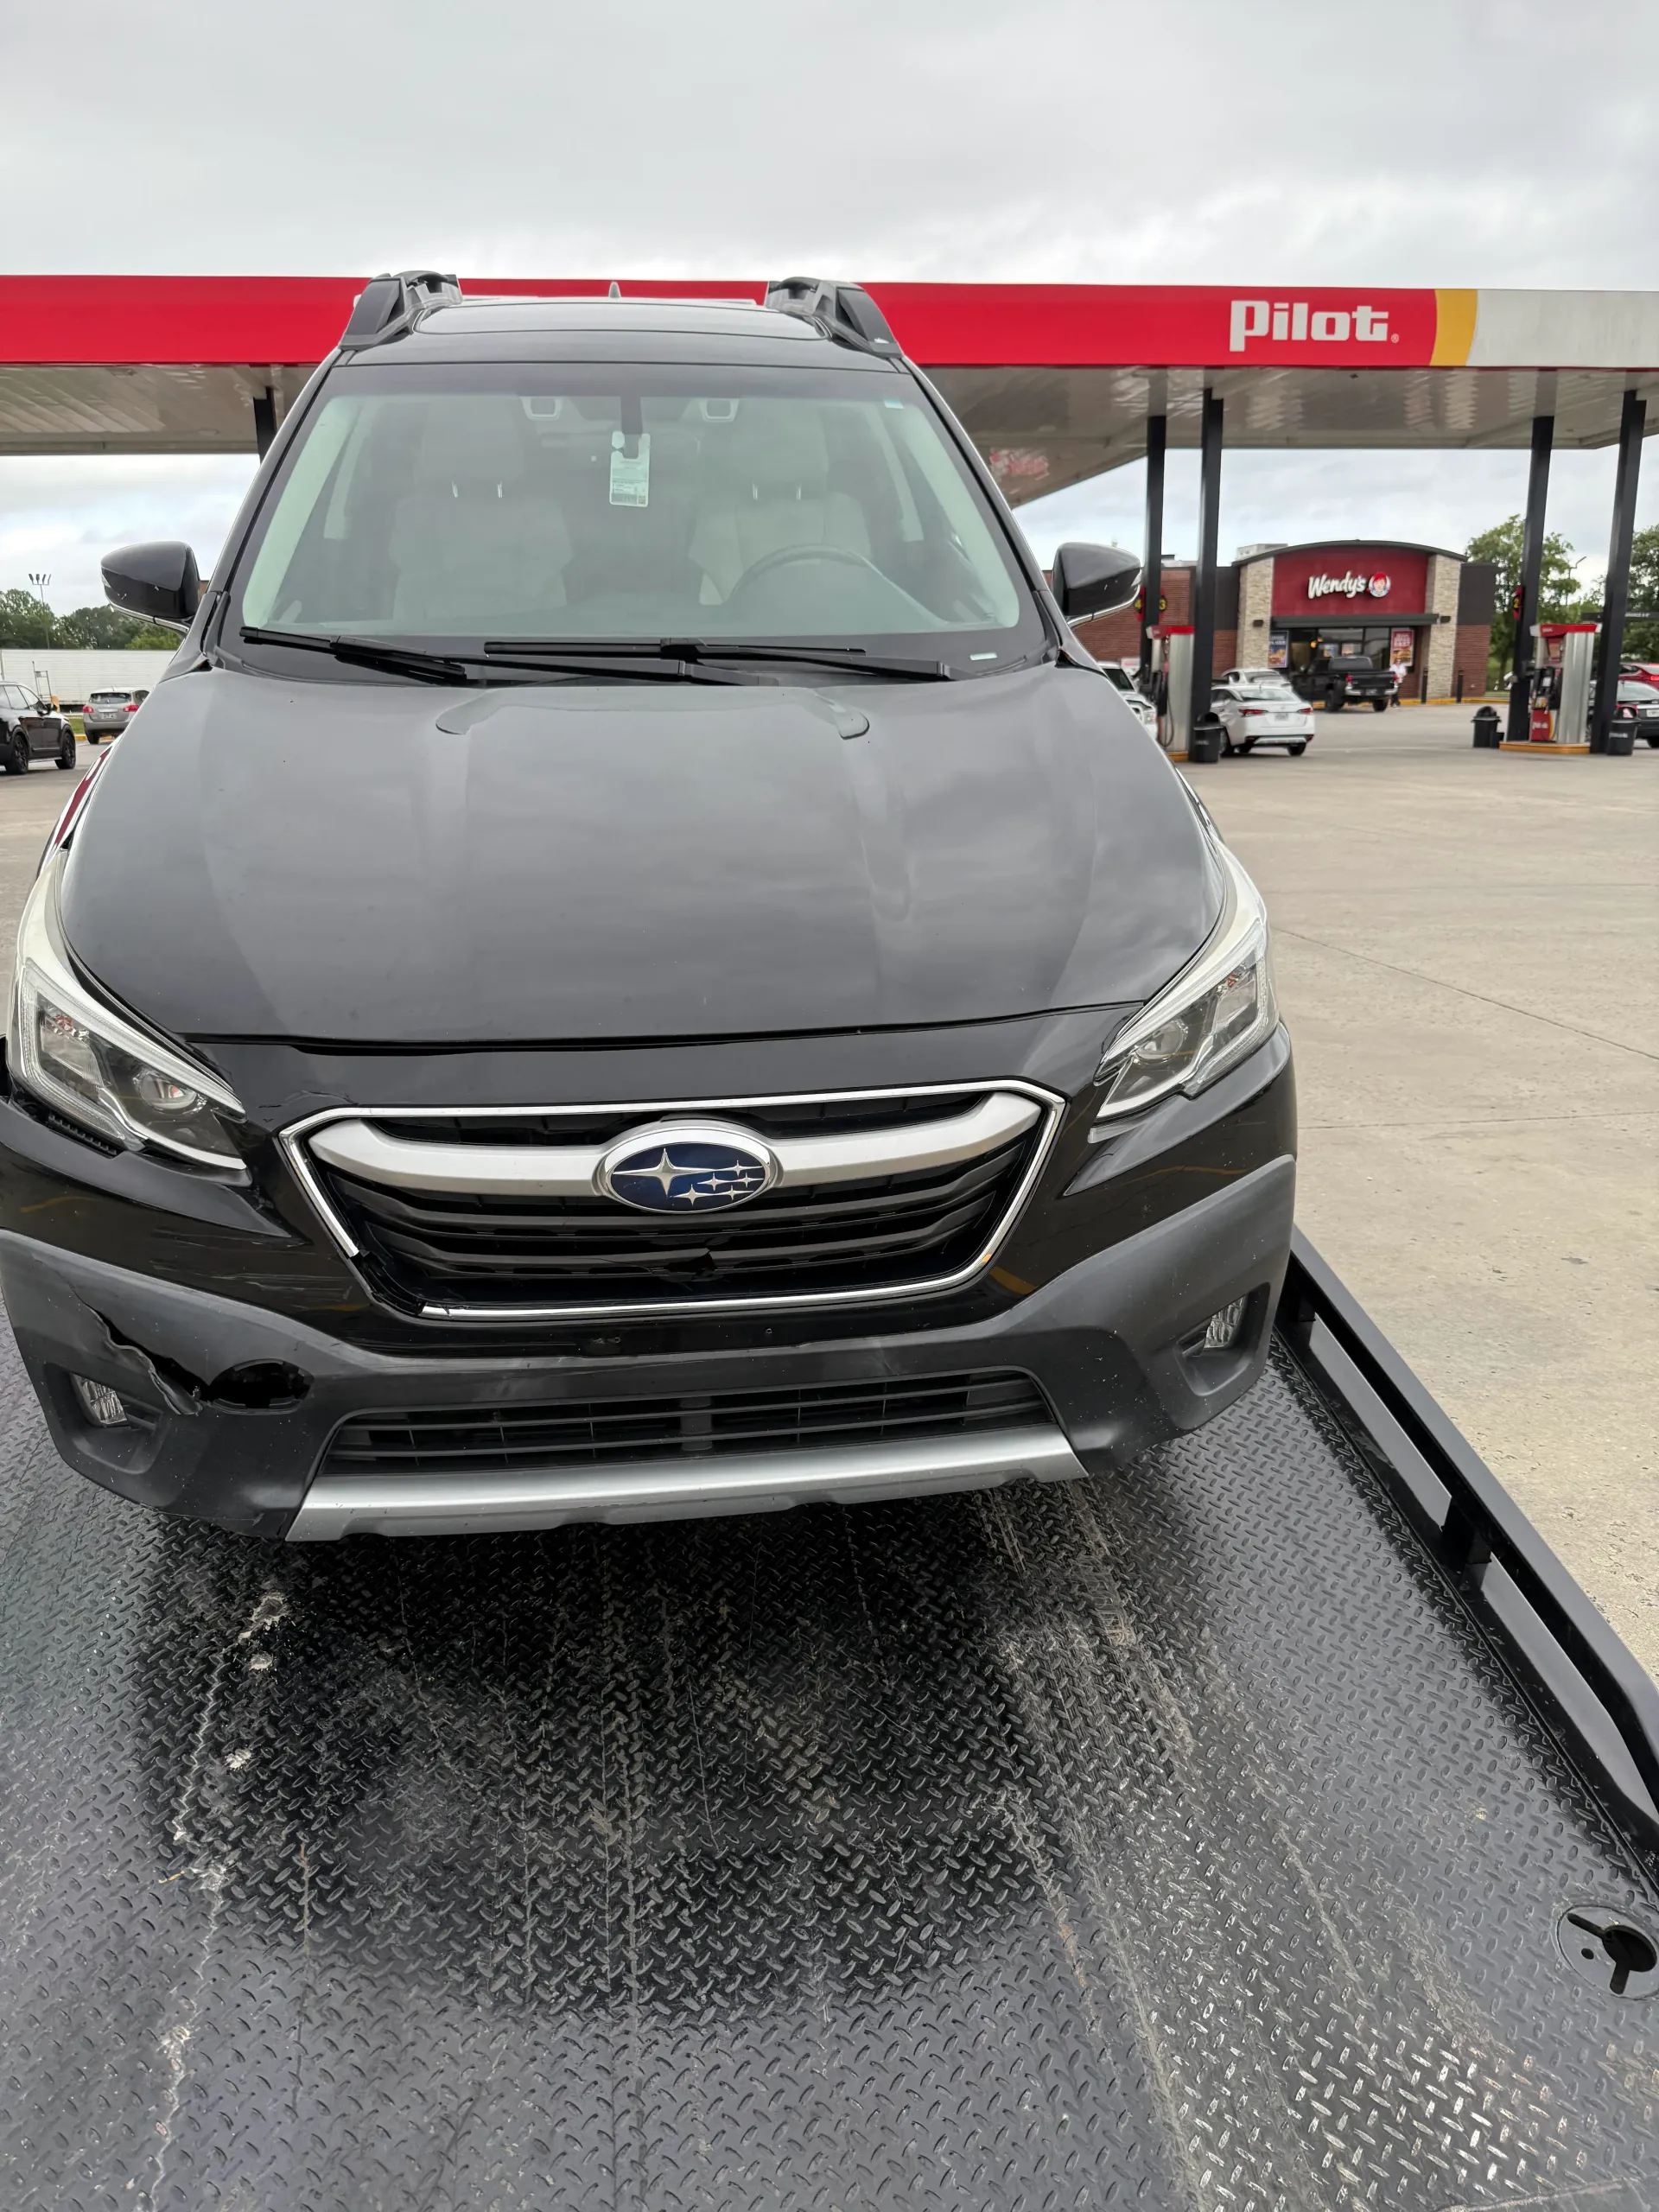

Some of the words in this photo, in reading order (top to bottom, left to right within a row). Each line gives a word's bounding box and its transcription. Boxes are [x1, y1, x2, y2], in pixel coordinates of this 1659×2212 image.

[1230, 300, 1389, 353] Pilot
[1307, 570, 1367, 600] Wendy's
[1159, 598, 1166, 611] 3
[1513, 597, 1521, 609] 2
